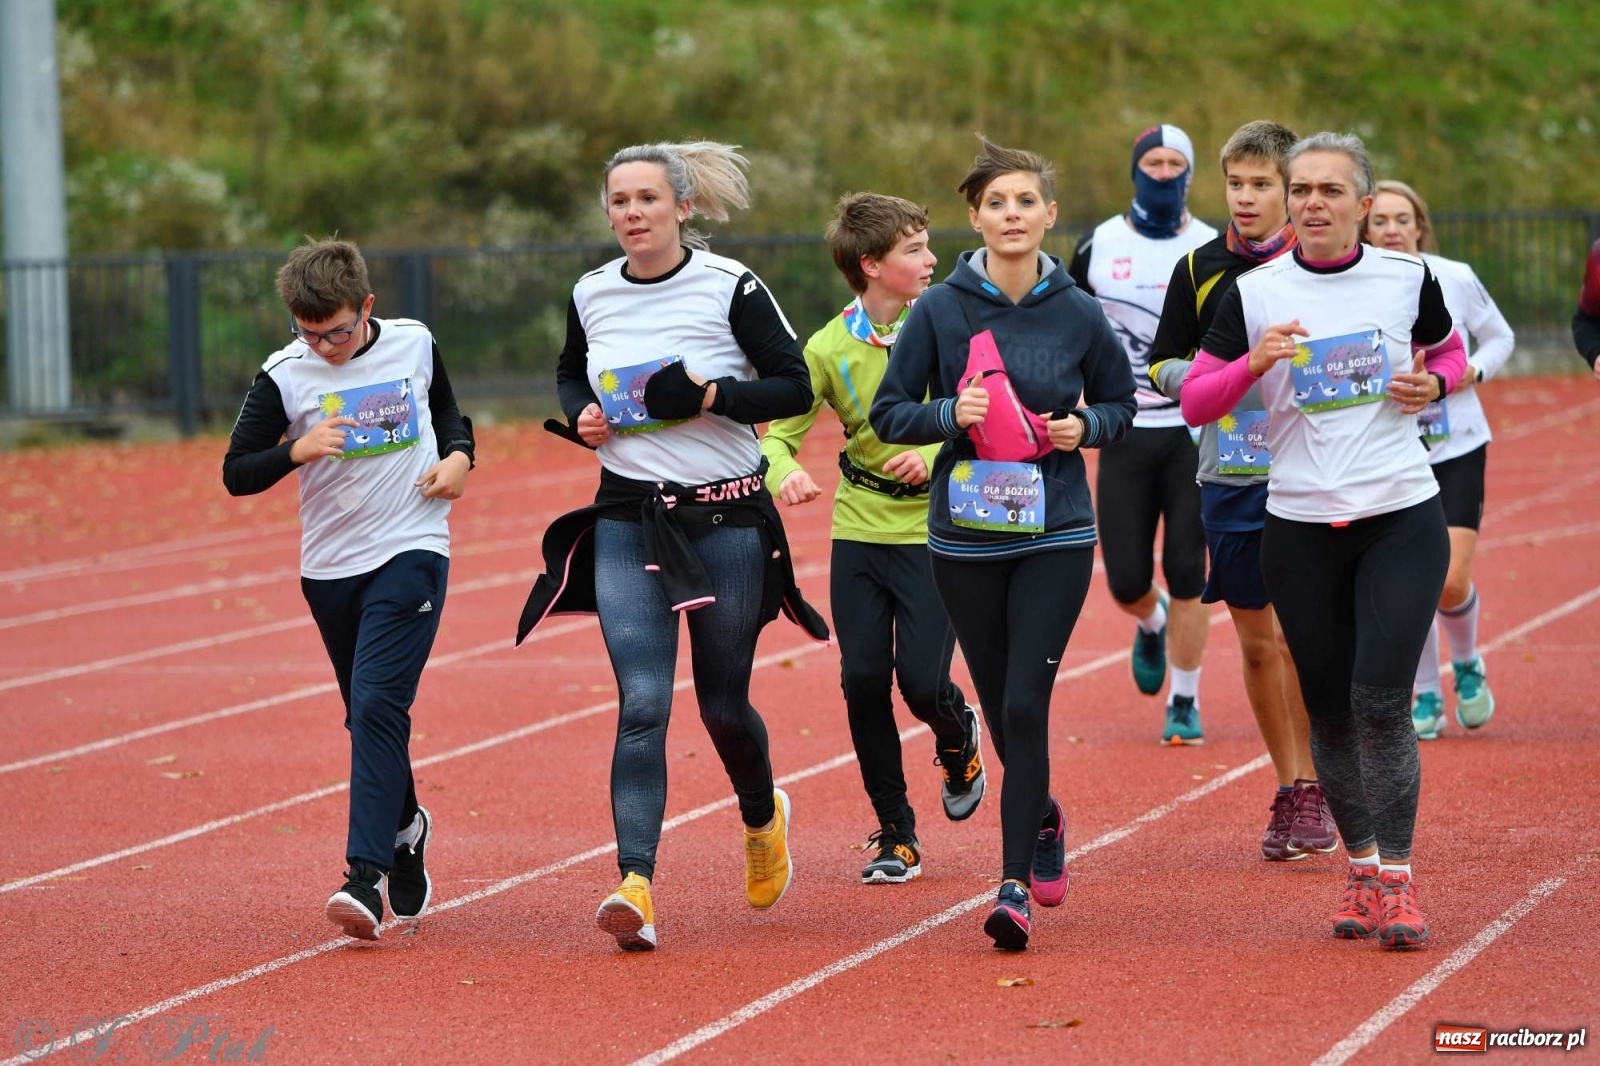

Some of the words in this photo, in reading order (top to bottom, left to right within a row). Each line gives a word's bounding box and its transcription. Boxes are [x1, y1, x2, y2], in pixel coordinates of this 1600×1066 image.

[1303, 365, 1322, 376] BIEG
[1327, 361, 1344, 372] DLA
[1350, 378, 1383, 394] 047
[611, 391, 629, 402] BIEG
[359, 410, 375, 420] DLA
[383, 423, 411, 443] 286
[1228, 433, 1244, 442] BIEG
[1247, 433, 1262, 442] DLA
[961, 483, 979, 493] BIEG
[984, 486, 1000, 495] DLA
[1007, 510, 1036, 523] 031
